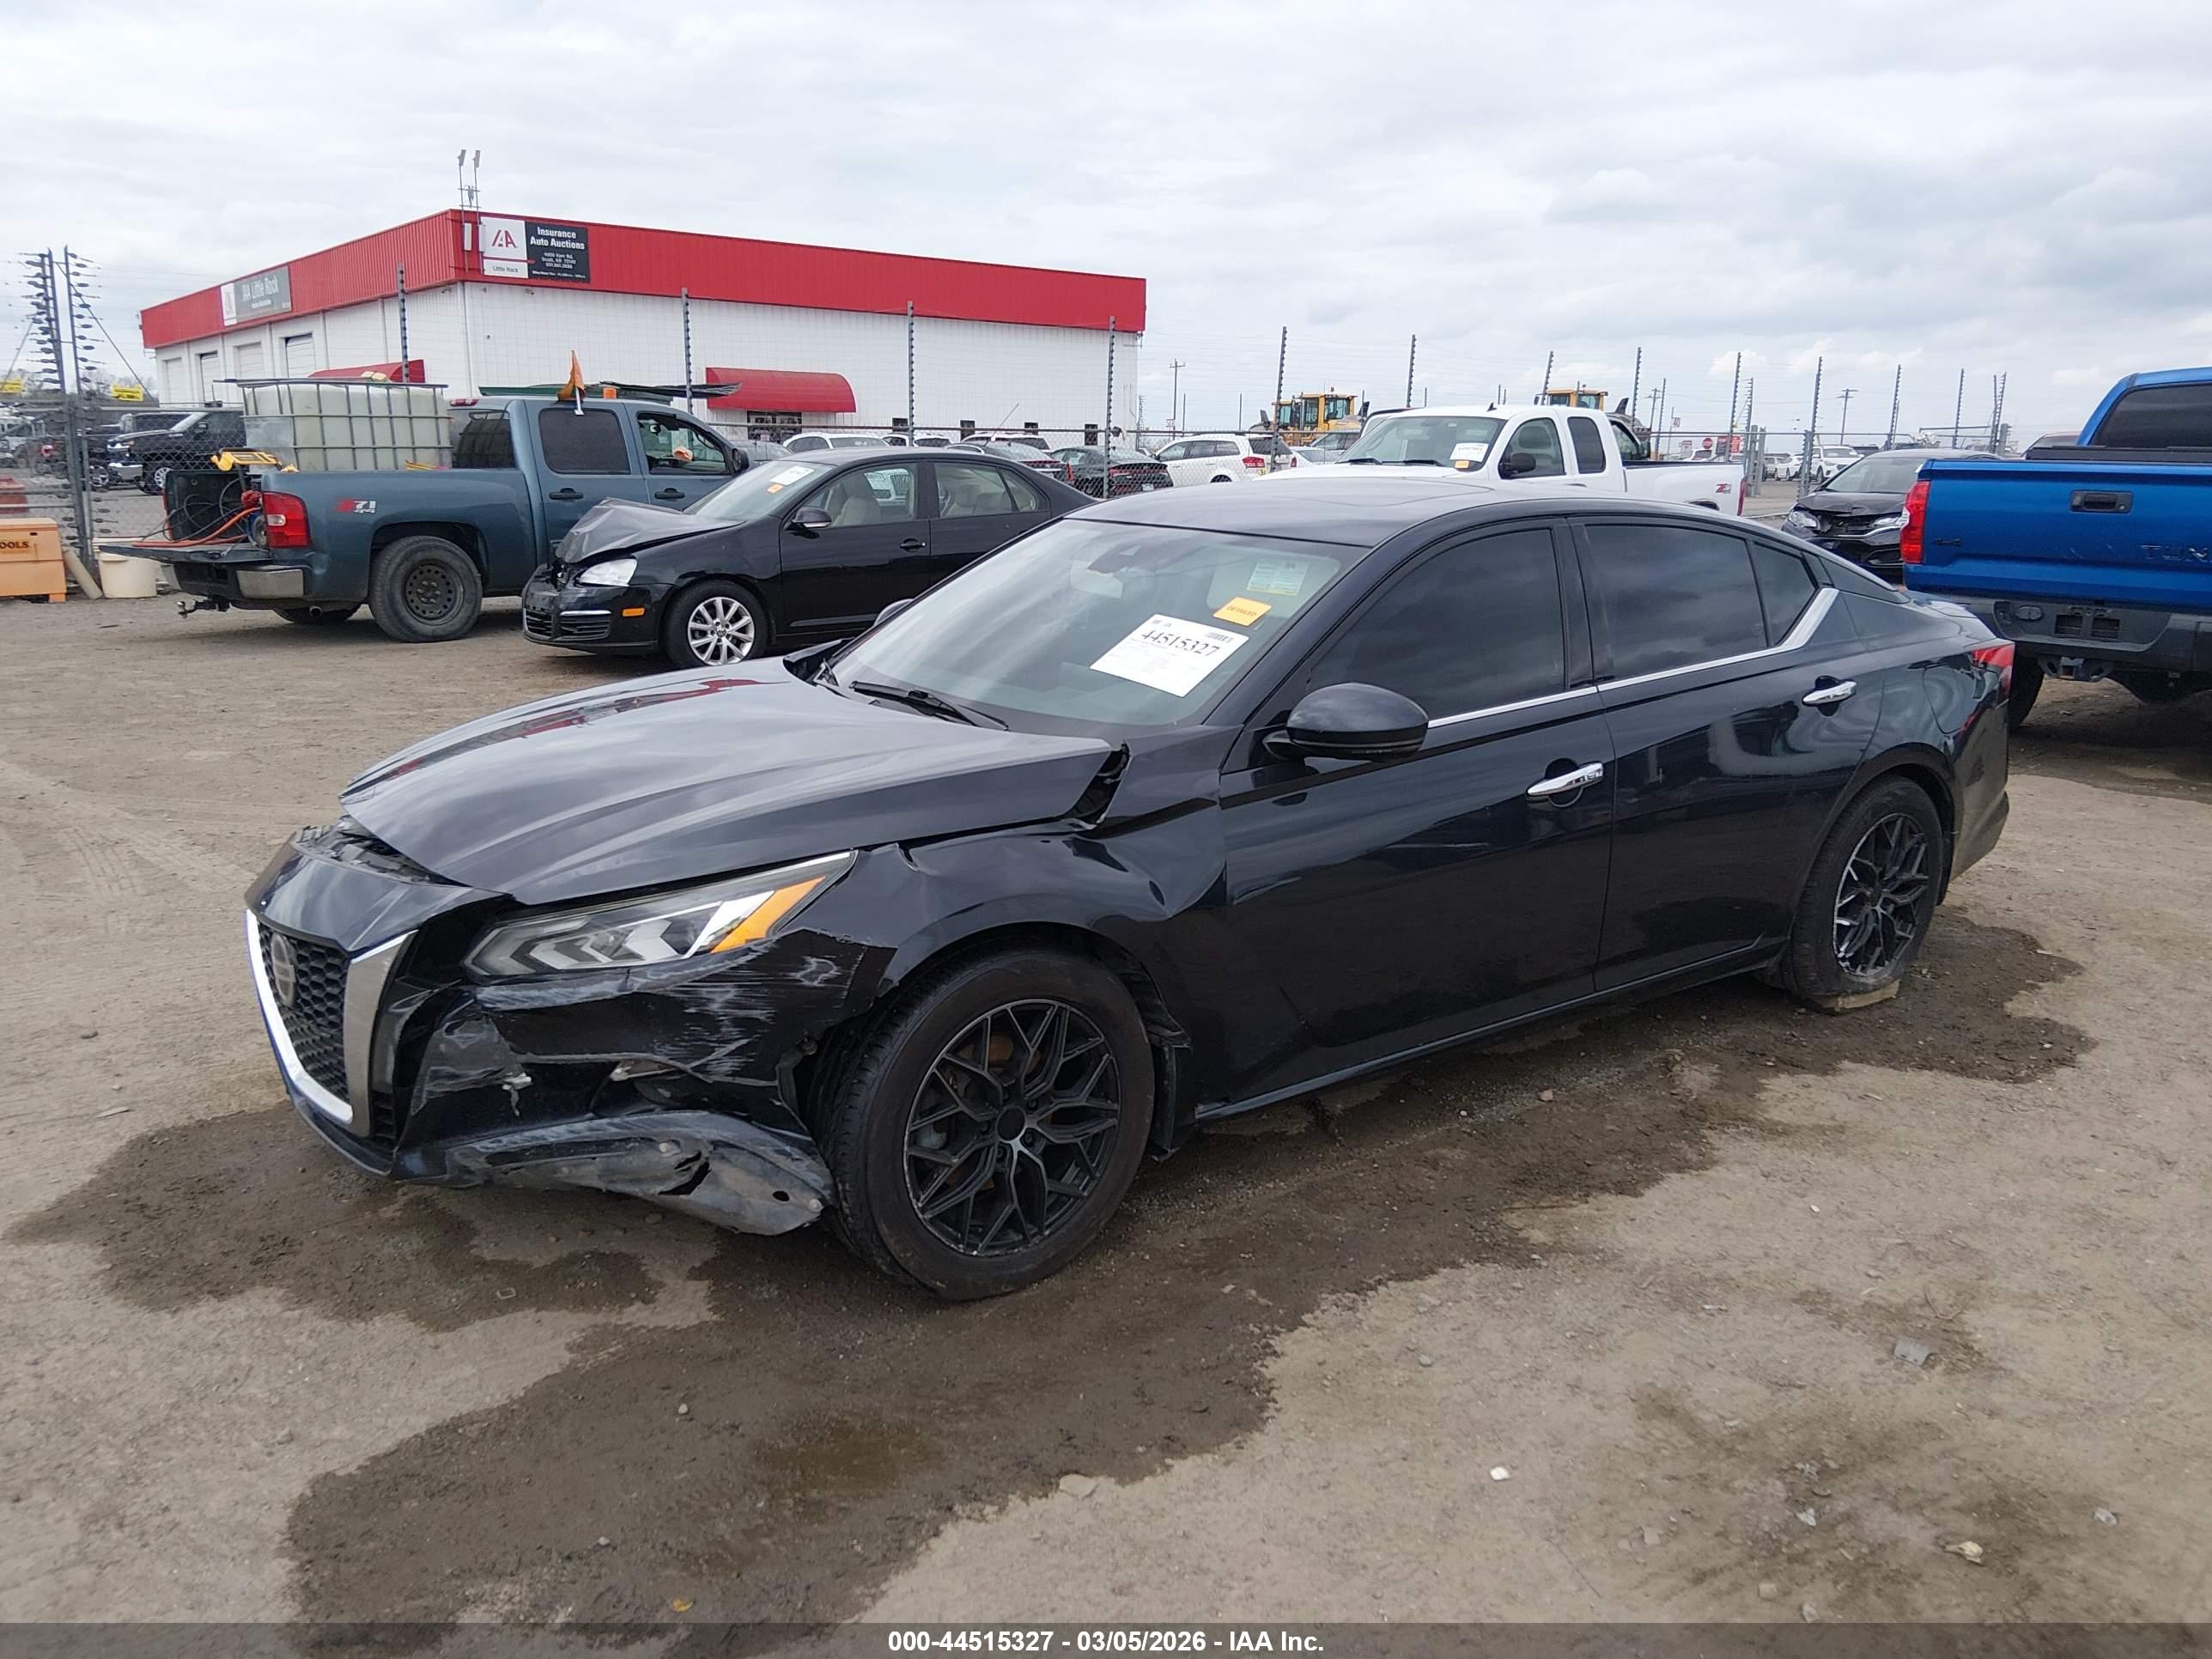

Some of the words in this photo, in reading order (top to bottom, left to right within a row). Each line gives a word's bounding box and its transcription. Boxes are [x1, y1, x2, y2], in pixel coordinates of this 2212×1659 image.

[537, 227, 576, 240] Insurance
[530, 236, 549, 246] Auto
[550, 238, 585, 250] Auctions
[2141, 544, 2212, 562] TUN
[1141, 629, 1221, 657] 44515327
